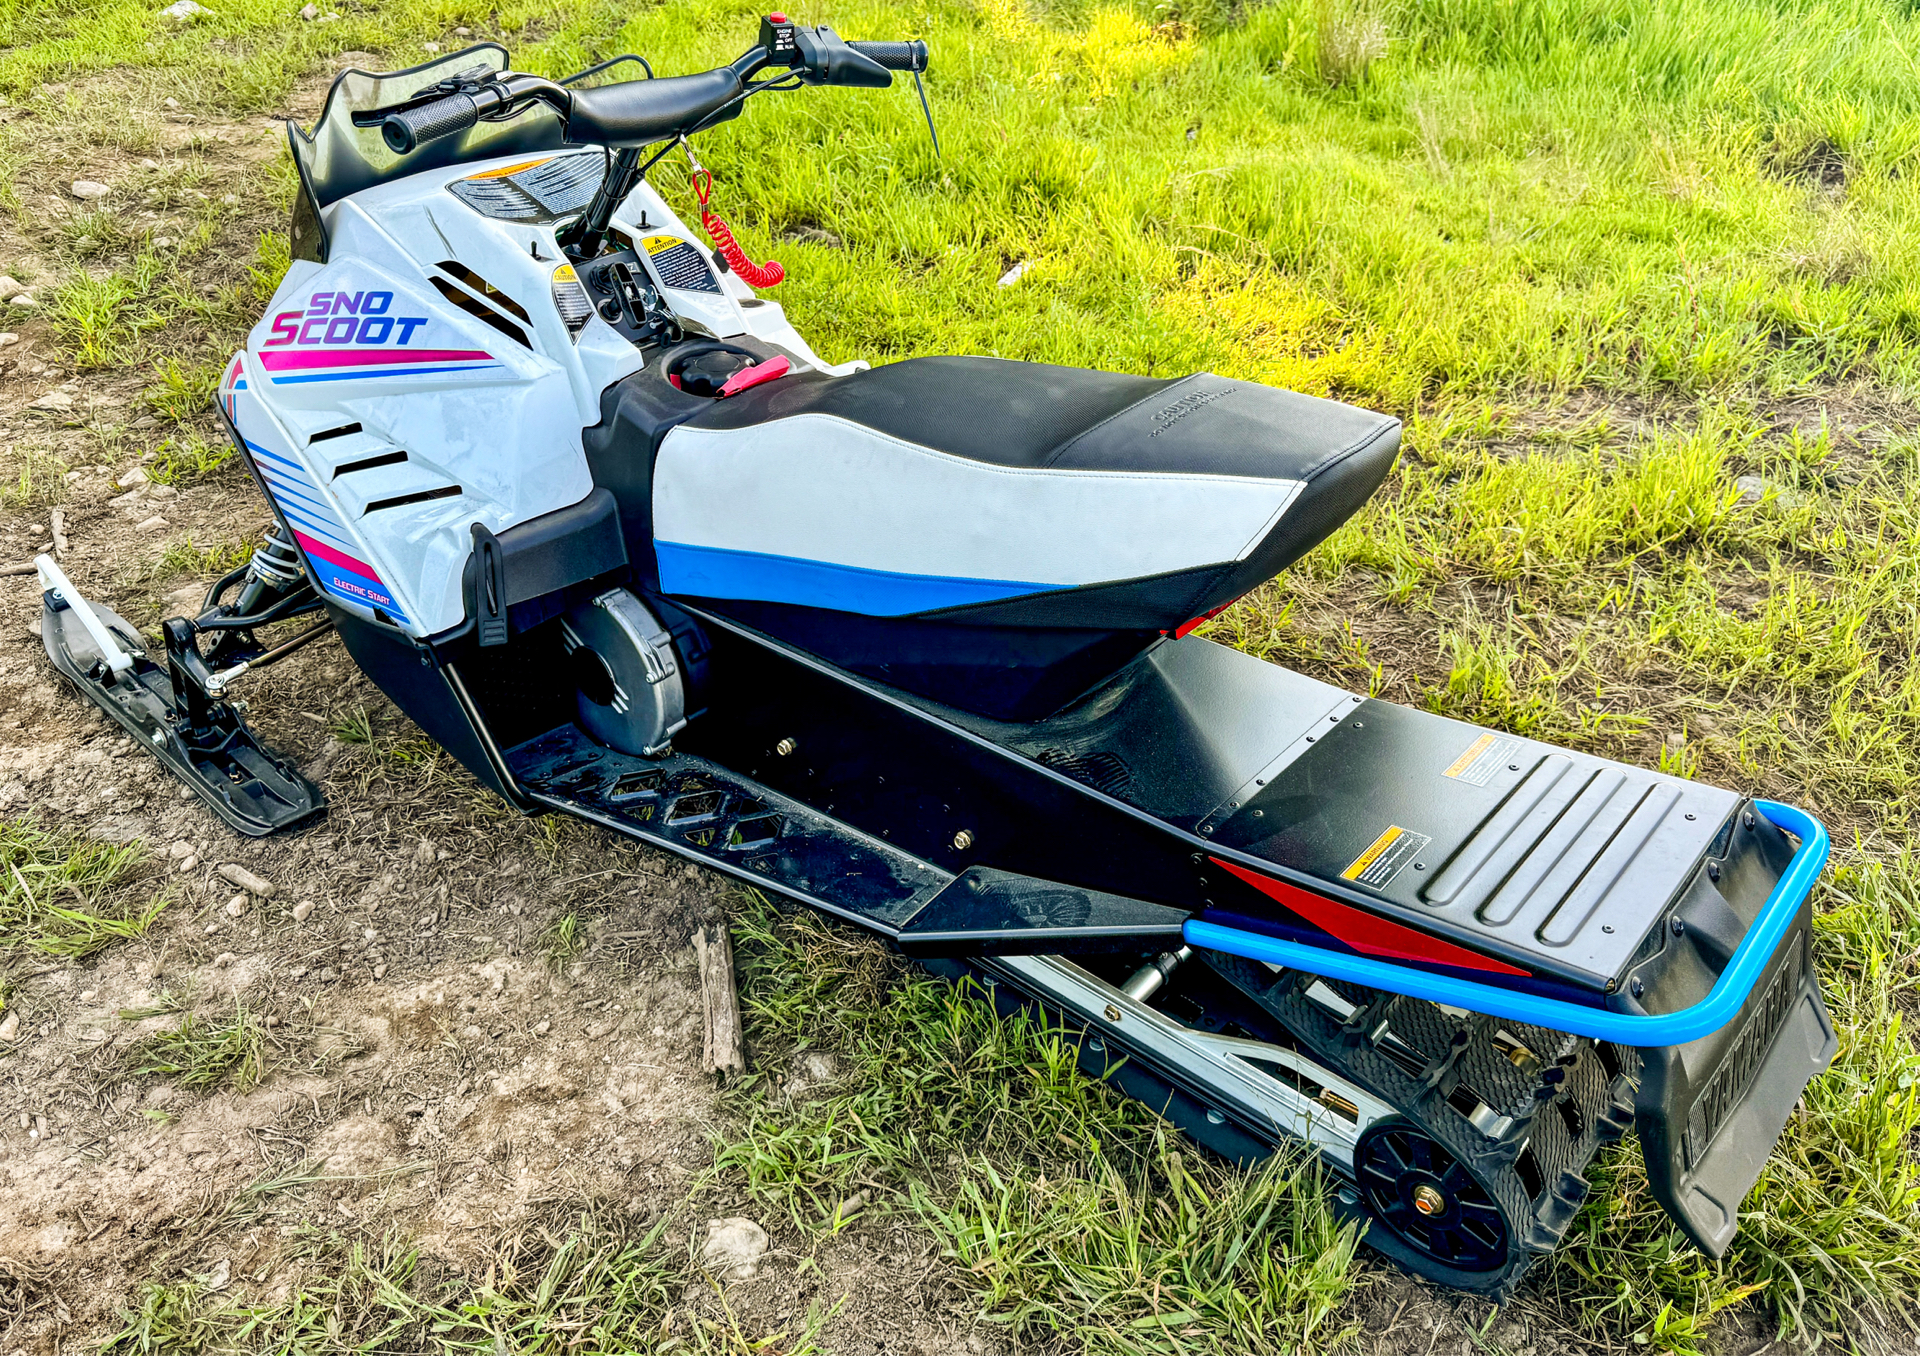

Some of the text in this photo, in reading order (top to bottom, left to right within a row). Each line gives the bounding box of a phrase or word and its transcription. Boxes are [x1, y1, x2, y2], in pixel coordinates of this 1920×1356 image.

[647, 238, 677, 254] ATTENTION
[306, 291, 394, 316] SNO
[263, 310, 429, 347] SCOOT
[1150, 389, 1213, 421] CAUTION
[333, 576, 390, 606] ELECTRIC START
[1364, 839, 1389, 861] WARNING
[1703, 961, 1790, 1143] YAMAHA
